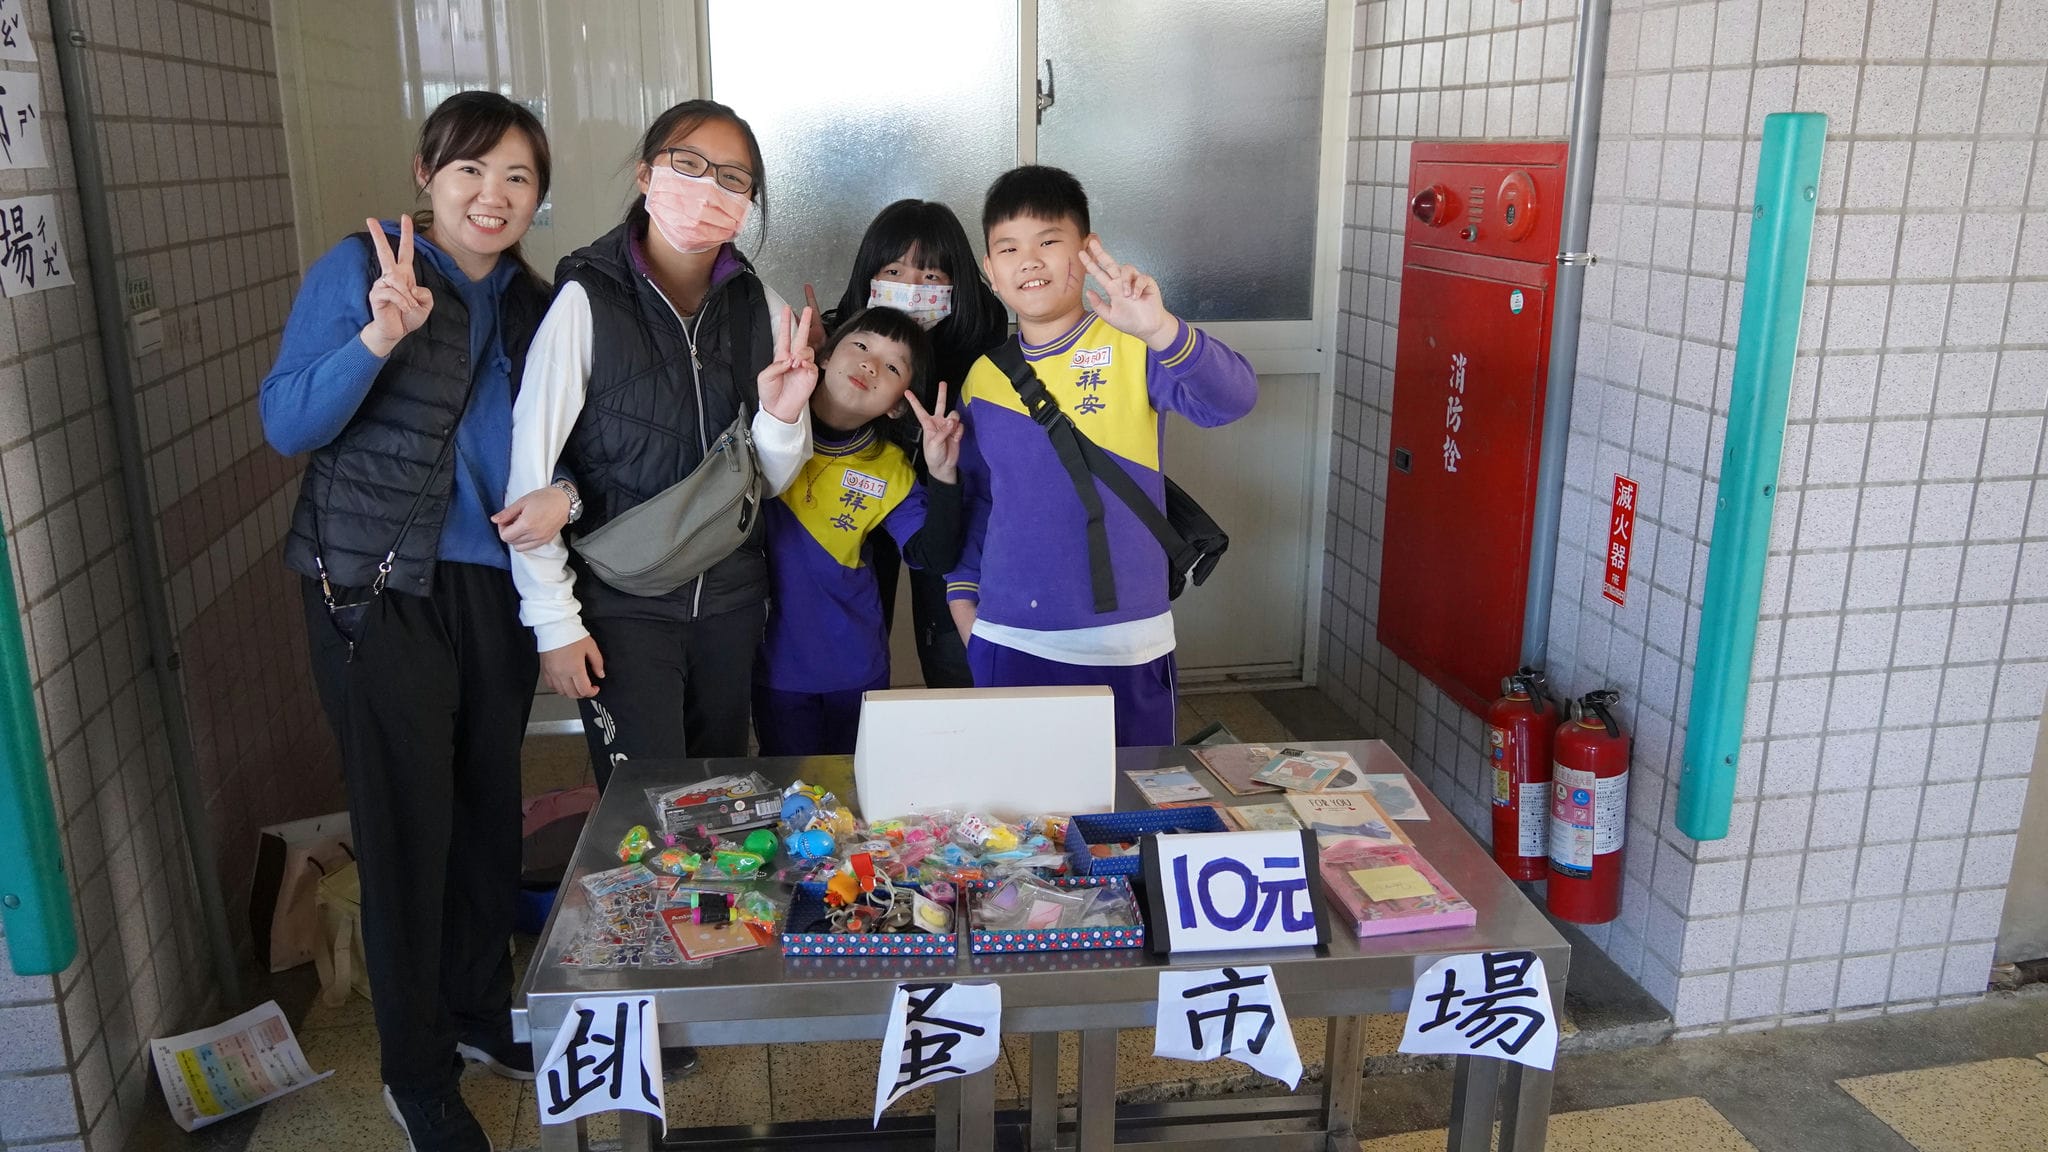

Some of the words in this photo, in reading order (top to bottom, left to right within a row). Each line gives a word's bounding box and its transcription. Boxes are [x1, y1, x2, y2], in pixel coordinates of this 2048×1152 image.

[0, 204, 34, 289] 場
[1084, 350, 1107, 364] 4507
[1074, 368, 1107, 416] 祥安
[1443, 351, 1467, 473] 消防栓
[830, 489, 868, 532] 祥安
[858, 479, 884, 494] 4517
[1610, 481, 1634, 571] 滅火器
[1308, 798, 1329, 807] FOR
[1329, 798, 1353, 807] YOU
[1172, 854, 1316, 932] 10元
[1182, 967, 1276, 1057] 市
[1418, 951, 1546, 1056] 場
